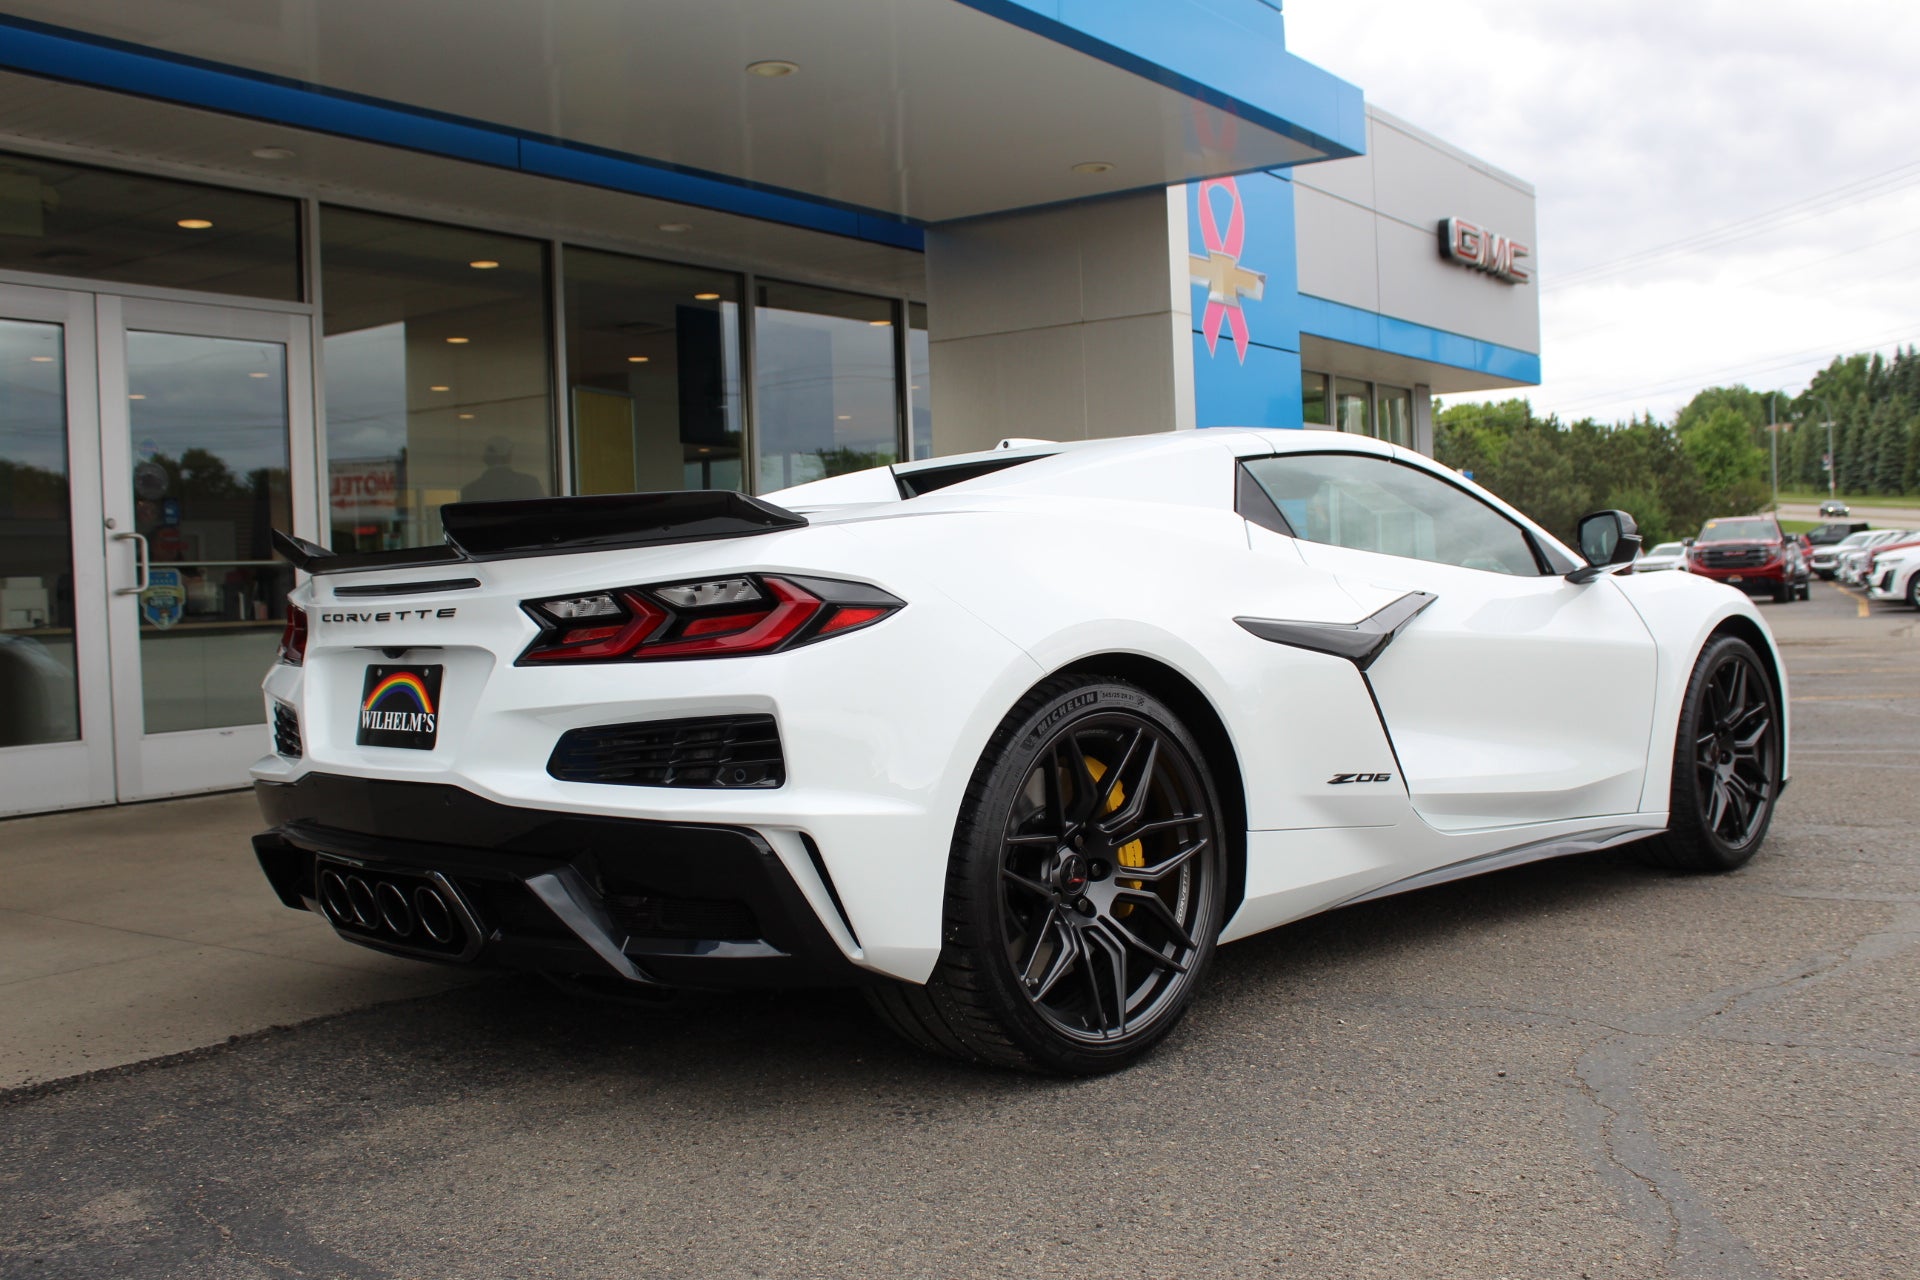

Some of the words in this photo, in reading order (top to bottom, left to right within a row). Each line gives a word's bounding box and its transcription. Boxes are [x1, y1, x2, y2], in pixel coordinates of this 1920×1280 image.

[1449, 217, 1530, 282] GMC
[321, 607, 457, 623] CORVETTE
[361, 710, 435, 733] WILHELM'S
[1036, 691, 1096, 736] MICHELIN
[1326, 773, 1392, 785] Z06
